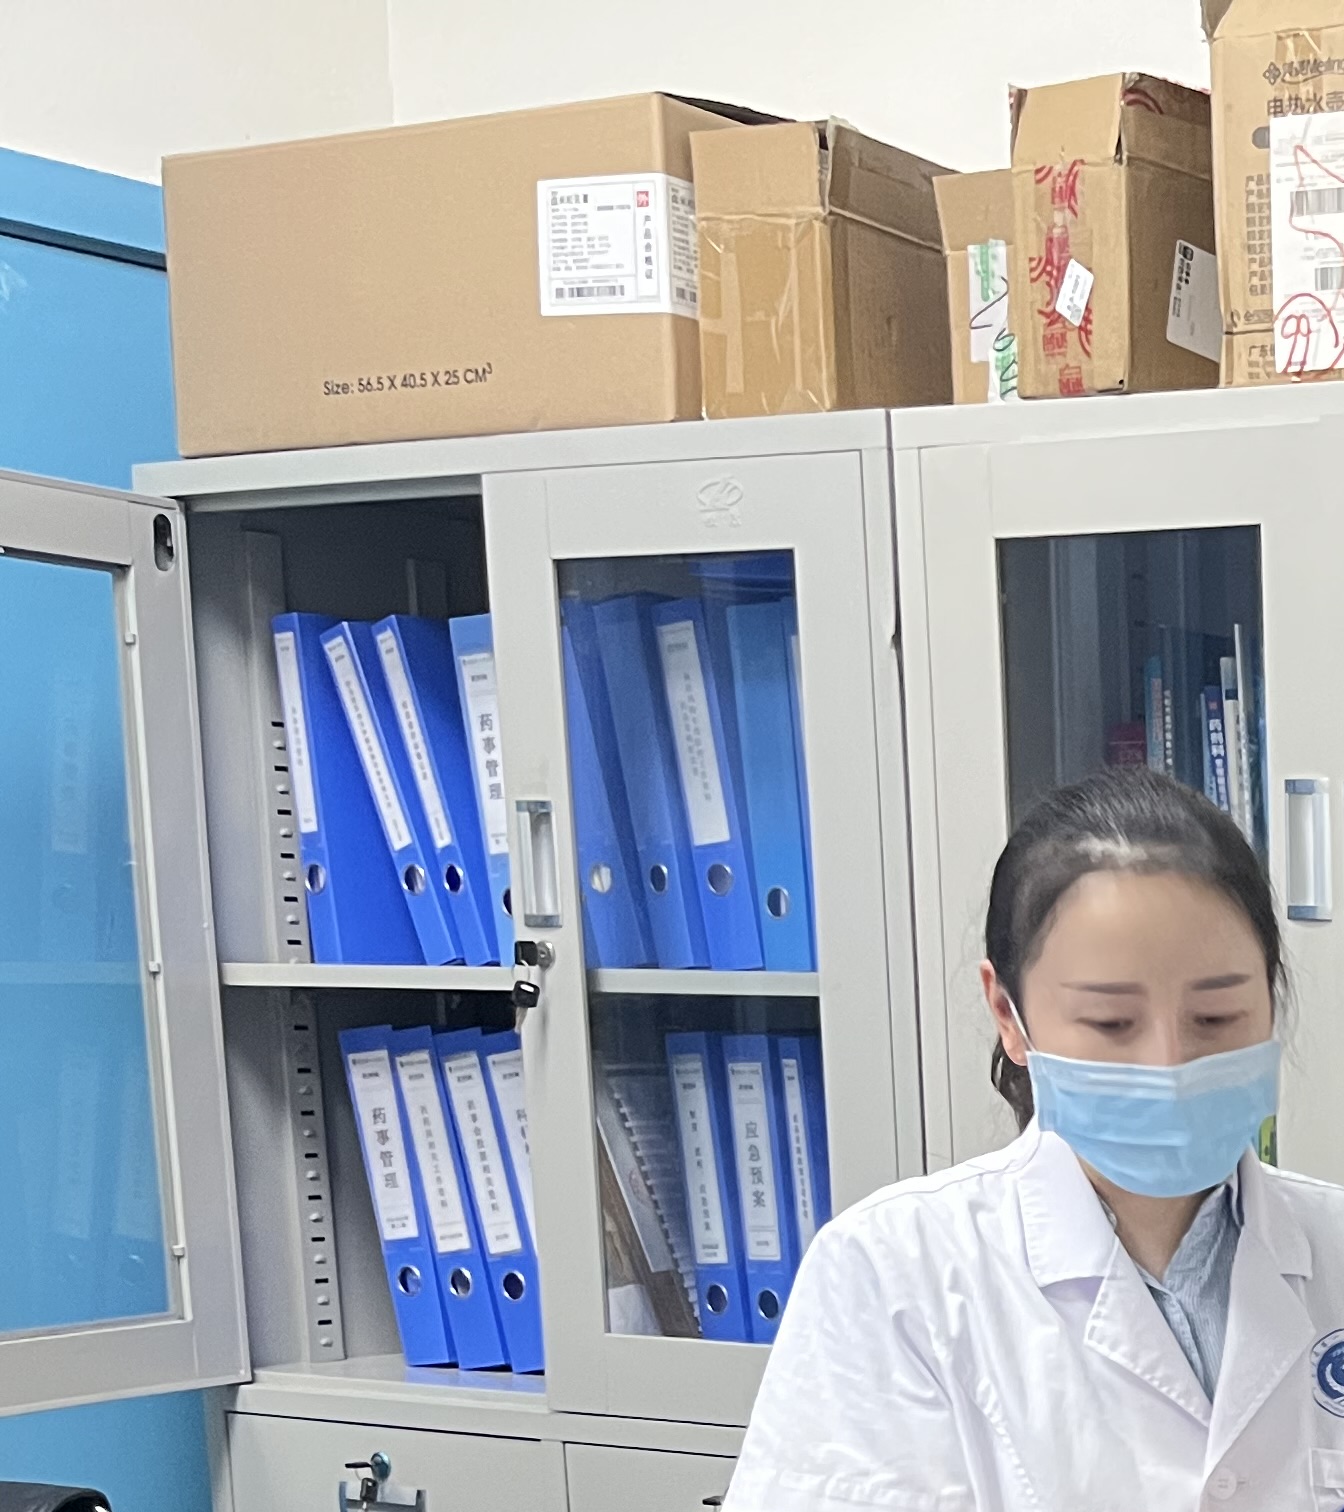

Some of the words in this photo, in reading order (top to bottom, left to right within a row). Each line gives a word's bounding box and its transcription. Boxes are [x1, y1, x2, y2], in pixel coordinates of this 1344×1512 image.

[1267, 90, 1344, 118] 电热水壶
[323, 380, 355, 396] Size:
[357, 376, 384, 393] 56.5
[387, 375, 398, 391] X
[400, 372, 428, 389] 40.5
[430, 370, 441, 387] X
[444, 369, 460, 386] 25
[479, 713, 504, 800] 药事管理
[372, 1106, 399, 1189] 药事管理
[745, 1121, 766, 1208] 应急预案
